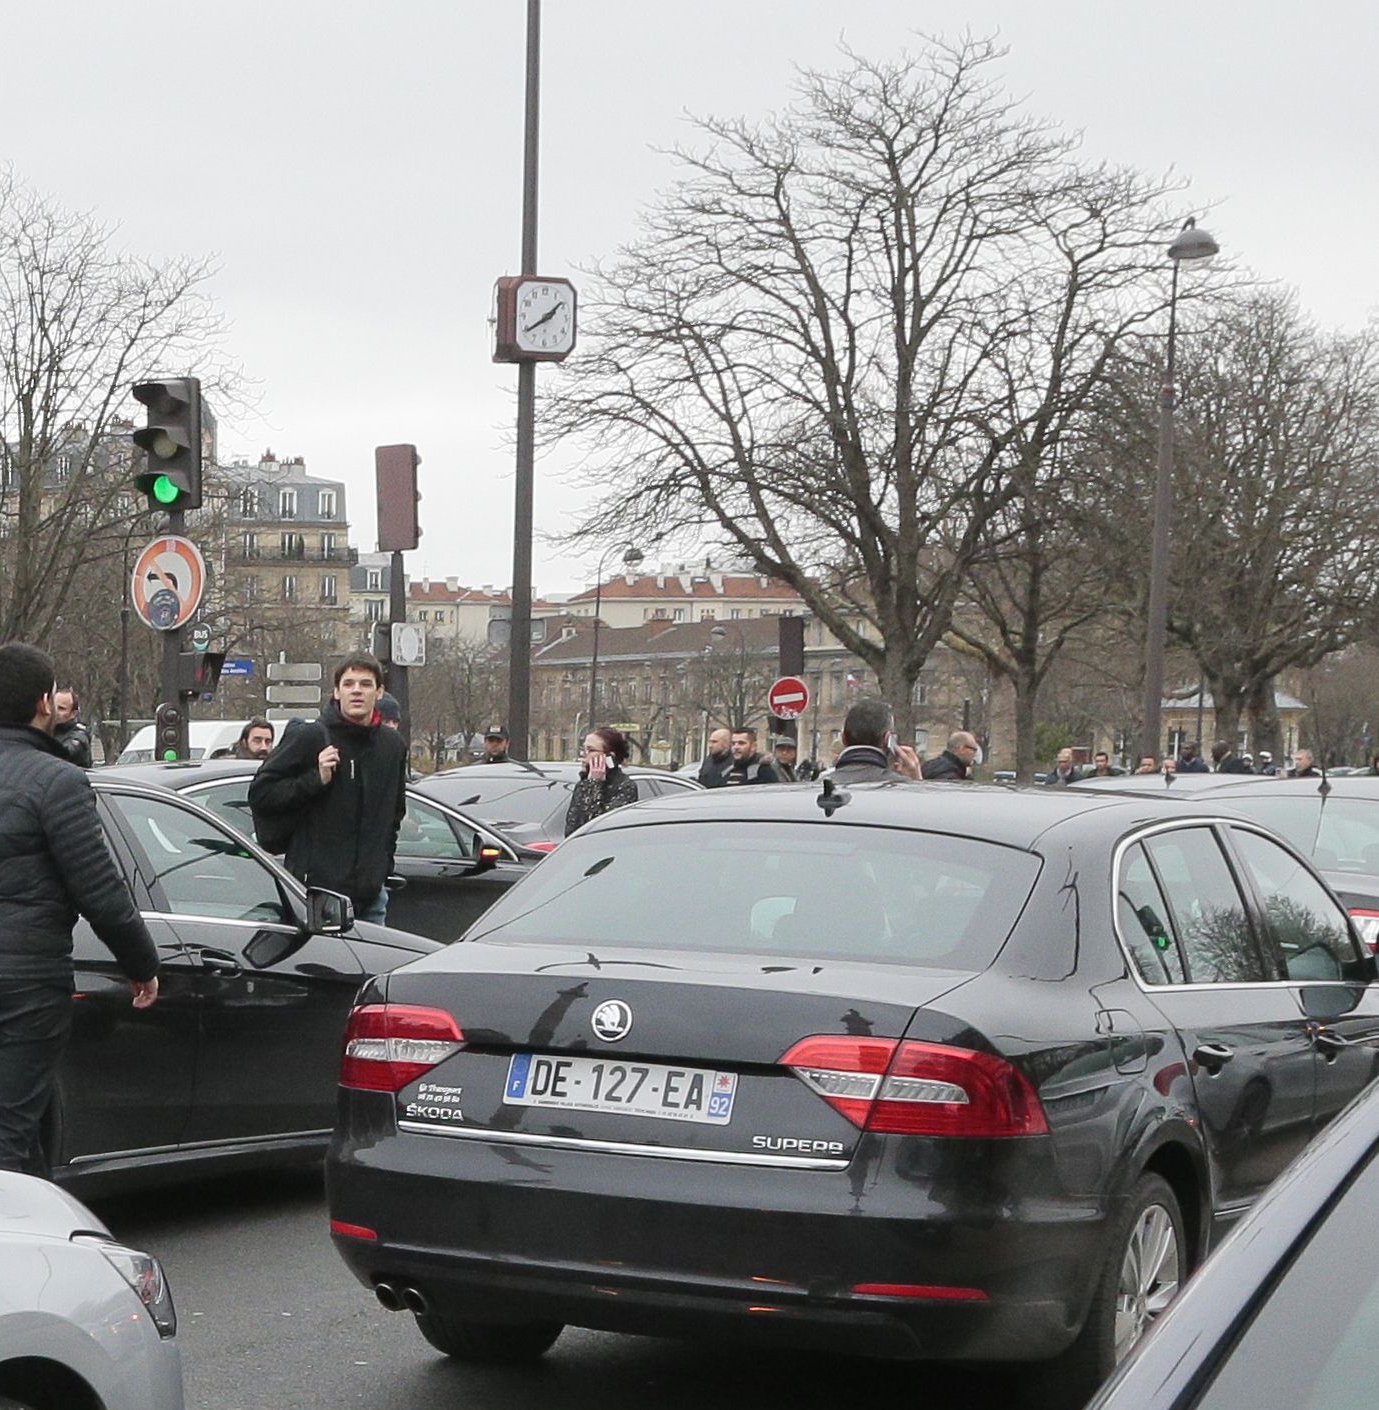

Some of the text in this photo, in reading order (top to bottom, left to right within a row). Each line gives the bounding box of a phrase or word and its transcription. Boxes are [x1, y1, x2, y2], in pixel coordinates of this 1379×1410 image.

[193, 630, 208, 639] BUS
[512, 1080, 520, 1091] F
[531, 1059, 704, 1111] DE-127-EA
[405, 1102, 464, 1121] ŠKODA
[709, 1096, 730, 1116] 92
[752, 1135, 844, 1154] SUPERB
